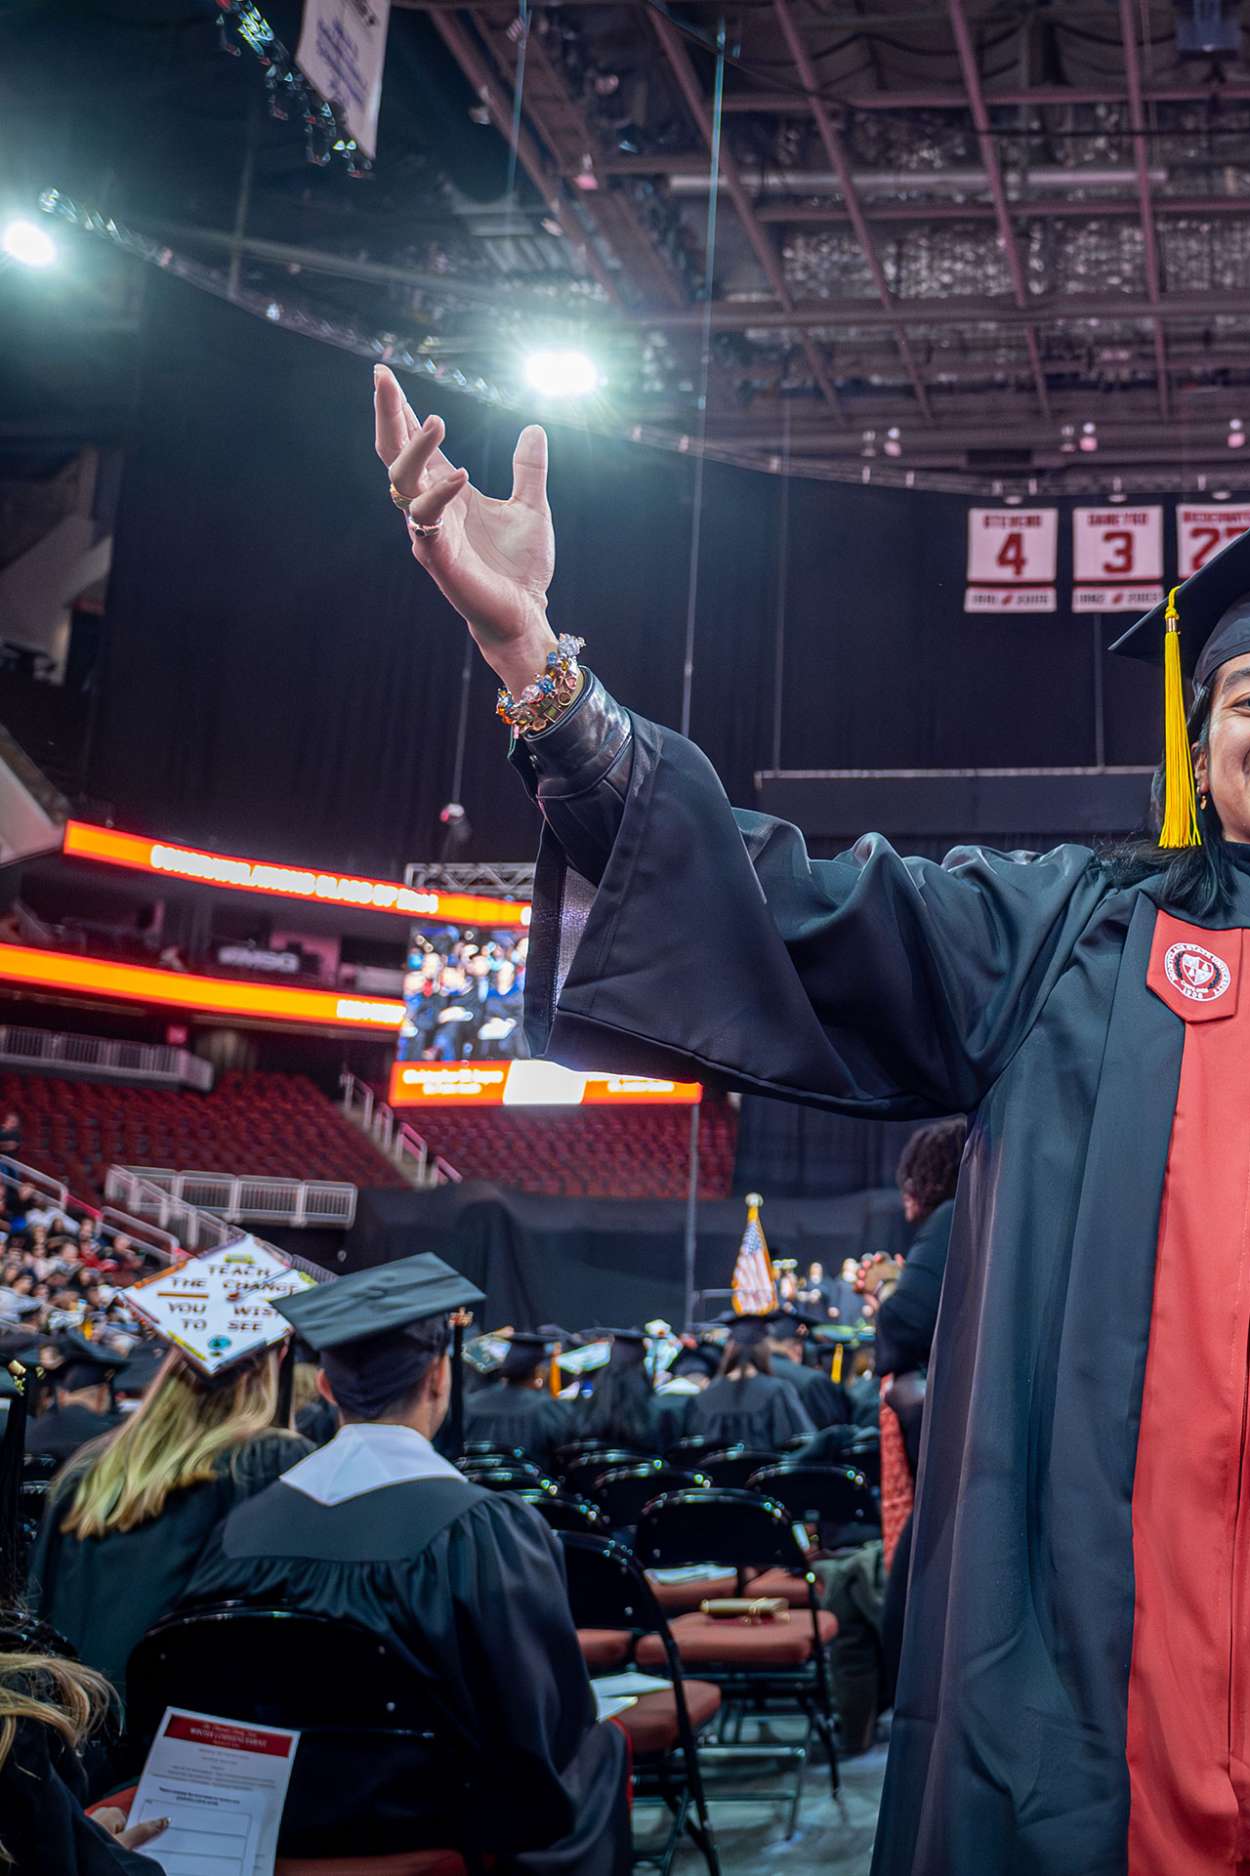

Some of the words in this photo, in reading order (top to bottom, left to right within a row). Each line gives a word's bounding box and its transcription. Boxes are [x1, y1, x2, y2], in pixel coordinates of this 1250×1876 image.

[996, 532, 1026, 576] 4
[1103, 531, 1133, 573] 3
[207, 1264, 270, 1276] TEACH
[172, 1277, 206, 1287] THE
[168, 1301, 207, 1313] YOU
[234, 1306, 281, 1318] WIS
[181, 1318, 207, 1331] TO
[228, 1320, 262, 1331] SEE
